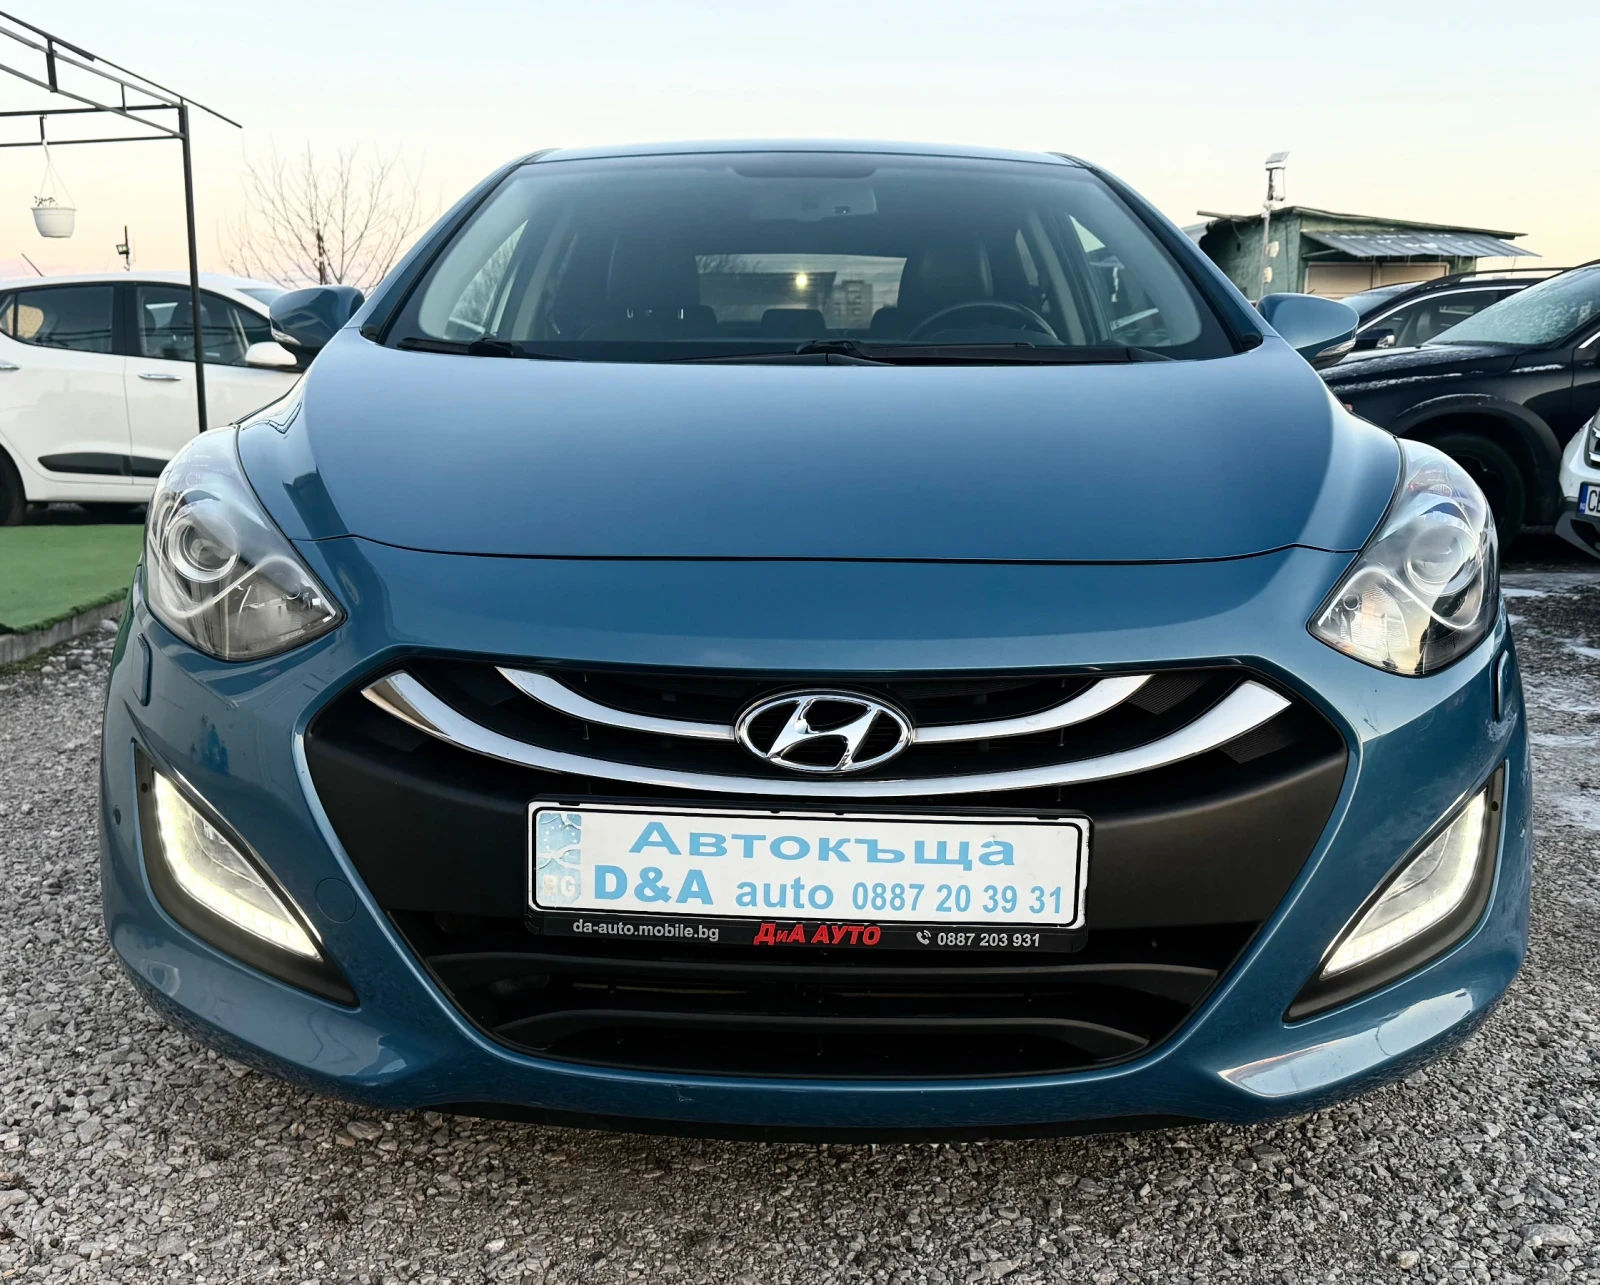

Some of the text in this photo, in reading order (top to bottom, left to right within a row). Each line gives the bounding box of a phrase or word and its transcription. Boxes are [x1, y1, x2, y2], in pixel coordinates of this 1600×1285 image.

[628, 821, 1015, 871] Автокъща
[594, 864, 1062, 914] D&A auto 0887 20 39 31
[572, 918, 719, 941] da-auto.mobile.bg
[753, 922, 882, 946] ДиА АУТО
[937, 932, 1040, 947] 0887 203 931
